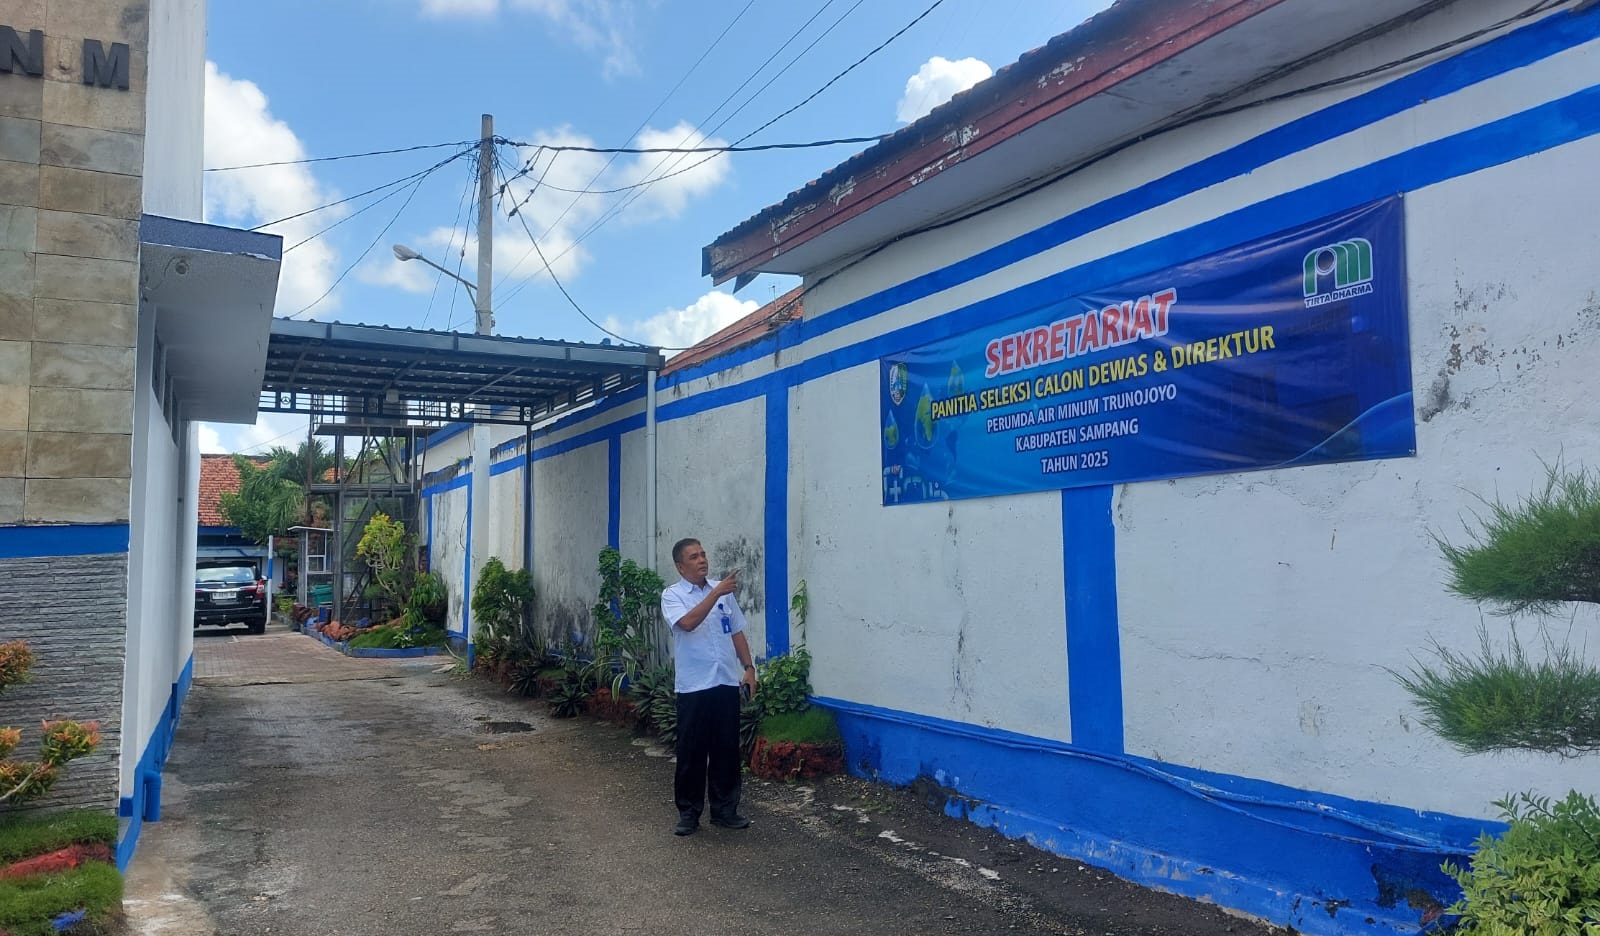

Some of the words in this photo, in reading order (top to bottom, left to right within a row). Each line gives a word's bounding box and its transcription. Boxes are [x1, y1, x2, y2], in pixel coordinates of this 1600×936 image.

[1304, 293, 1332, 308] TIRTA
[1332, 283, 1374, 301] DHARMA
[985, 288, 1177, 378] SEKRETARIAT
[932, 394, 977, 419] PANITIA
[981, 381, 1030, 409] SELEKSI
[1035, 369, 1083, 396] CALON
[1089, 353, 1148, 386] DEWAS
[1154, 351, 1167, 372] &
[1171, 325, 1275, 369] DIREKTUR
[987, 411, 1035, 432] PERUMDA
[1038, 407, 1055, 423] AIR
[1058, 398, 1098, 420] MINUM
[1102, 383, 1177, 412] TRUNOJOYO
[1016, 428, 1076, 451] KABUPATEN
[1080, 418, 1139, 442] SAMPANG
[1041, 455, 1077, 473] TAHUN
[1081, 451, 1108, 469] 2025
